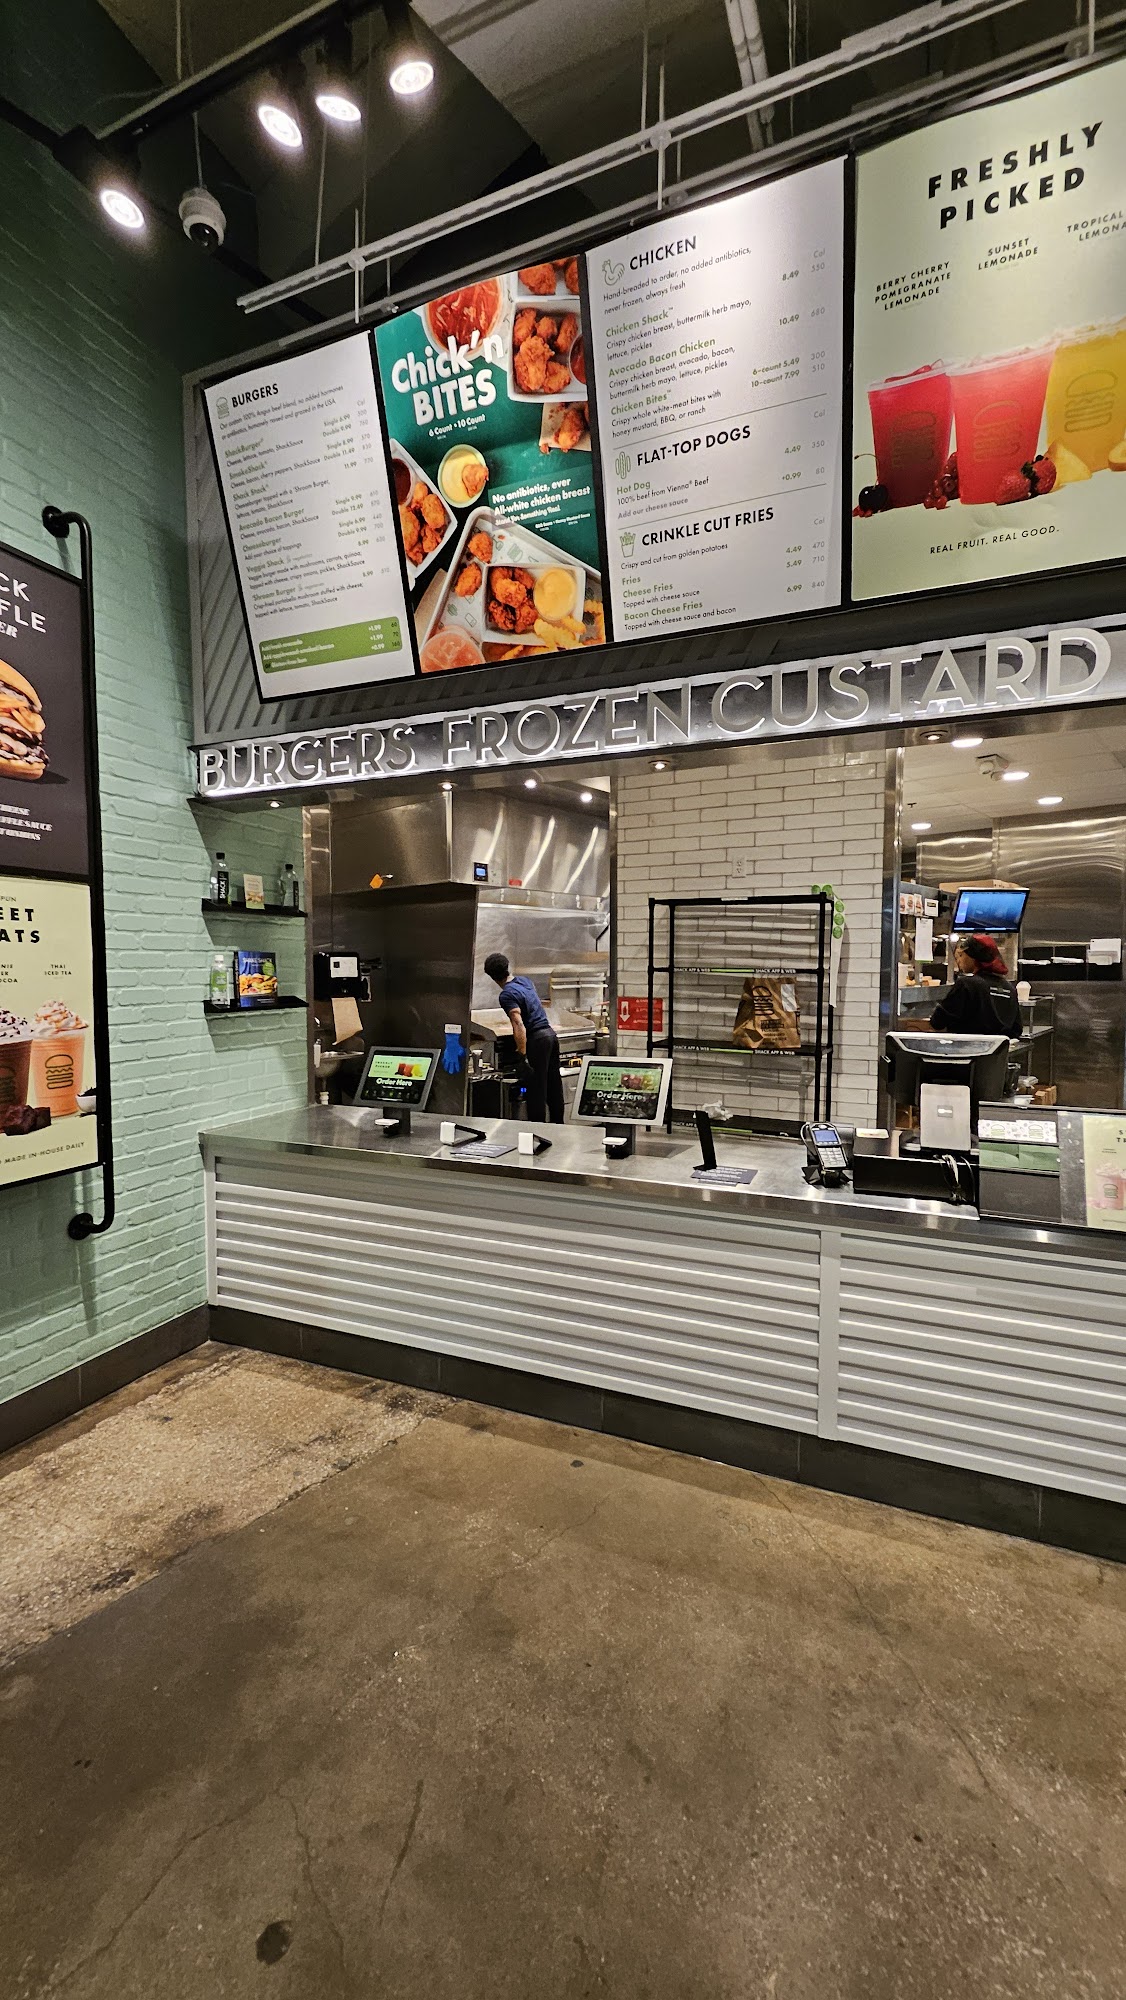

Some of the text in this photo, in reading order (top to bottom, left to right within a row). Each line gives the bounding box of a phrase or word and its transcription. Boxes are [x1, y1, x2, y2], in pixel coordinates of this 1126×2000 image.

[928, 121, 1103, 199] FRESHLY
[940, 167, 1085, 230] PICKED
[1066, 210, 1123, 233] TROPICAL
[629, 235, 696, 271] CHICKEN
[978, 246, 1039, 270] LEMONADE
[988, 238, 1030, 256] SUNSET
[603, 247, 752, 302] Hand-breaded to order, no added antibiotics,
[781, 269, 800, 282] 8.49
[876, 262, 950, 292] BERRY CHERRY
[604, 279, 686, 315] never frozen, always fresh
[874, 272, 952, 304] POMEGRANATE
[884, 286, 940, 310] LEMONADE
[605, 321, 640, 338] Chicken
[606, 299, 752, 350] Crispy chicken breast, buttermilk herb mayo,
[779, 313, 800, 326] 10.49
[392, 329, 504, 393] Chick'n
[606, 341, 653, 362] lettuce, pickles
[608, 338, 716, 378] Avocado Bacon Chicken
[608, 346, 736, 389] Crispy chicken breast, avocado, bacon,
[752, 356, 800, 376] 6-count 5.49
[609, 359, 728, 400] buttermilk herb mayo, lettuce, pickles
[751, 369, 800, 390] 10-count 7.99
[231, 383, 279, 408] BURGERS
[412, 369, 496, 426] BITES
[610, 400, 644, 416] Chicken
[611, 389, 722, 427] Crispy whole white-meat bites with
[429, 428, 434, 437] 6
[434, 424, 452, 436] Count
[457, 419, 466, 429] 10
[466, 414, 486, 427] Count
[611, 405, 706, 439] honey mustard, BBQ, or ranch
[636, 424, 751, 467] FLAT-TOP DOGS
[784, 444, 802, 454] 4.49
[781, 471, 802, 481] +0.99
[492, 478, 572, 504] No antibiotics, ever
[616, 481, 651, 496] Hot Dog
[617, 495, 636, 506] 100%
[636, 490, 651, 501] beef
[651, 489, 666, 498] from
[694, 475, 709, 487] Beef
[494, 486, 591, 516] All-white chicken breast
[617, 498, 689, 520] Add our cheese sauce
[641, 506, 774, 546] CRINKLE CUT FRIES
[785, 545, 803, 554] 4.49
[930, 525, 1060, 554] REAL FRUIT. REAL GOOD.
[620, 543, 728, 570] Crispy and cut from golden potatoes
[786, 559, 802, 569] 5.49
[621, 576, 641, 586] Fries
[622, 582, 673, 599] Cheese Fries
[786, 584, 803, 593] 6.99
[622, 590, 700, 609] Topped with cheese sauce
[623, 600, 703, 621] Bacon Cheese Fries
[624, 607, 737, 632] Topped with cheese sauce and bacon
[198, 627, 1112, 794] BURGERS FROZEN CUSTARD
[596, 1091, 643, 1100] Order Here
[4, 1142, 84, 1164] MADE IN-HOUSE DAILY
